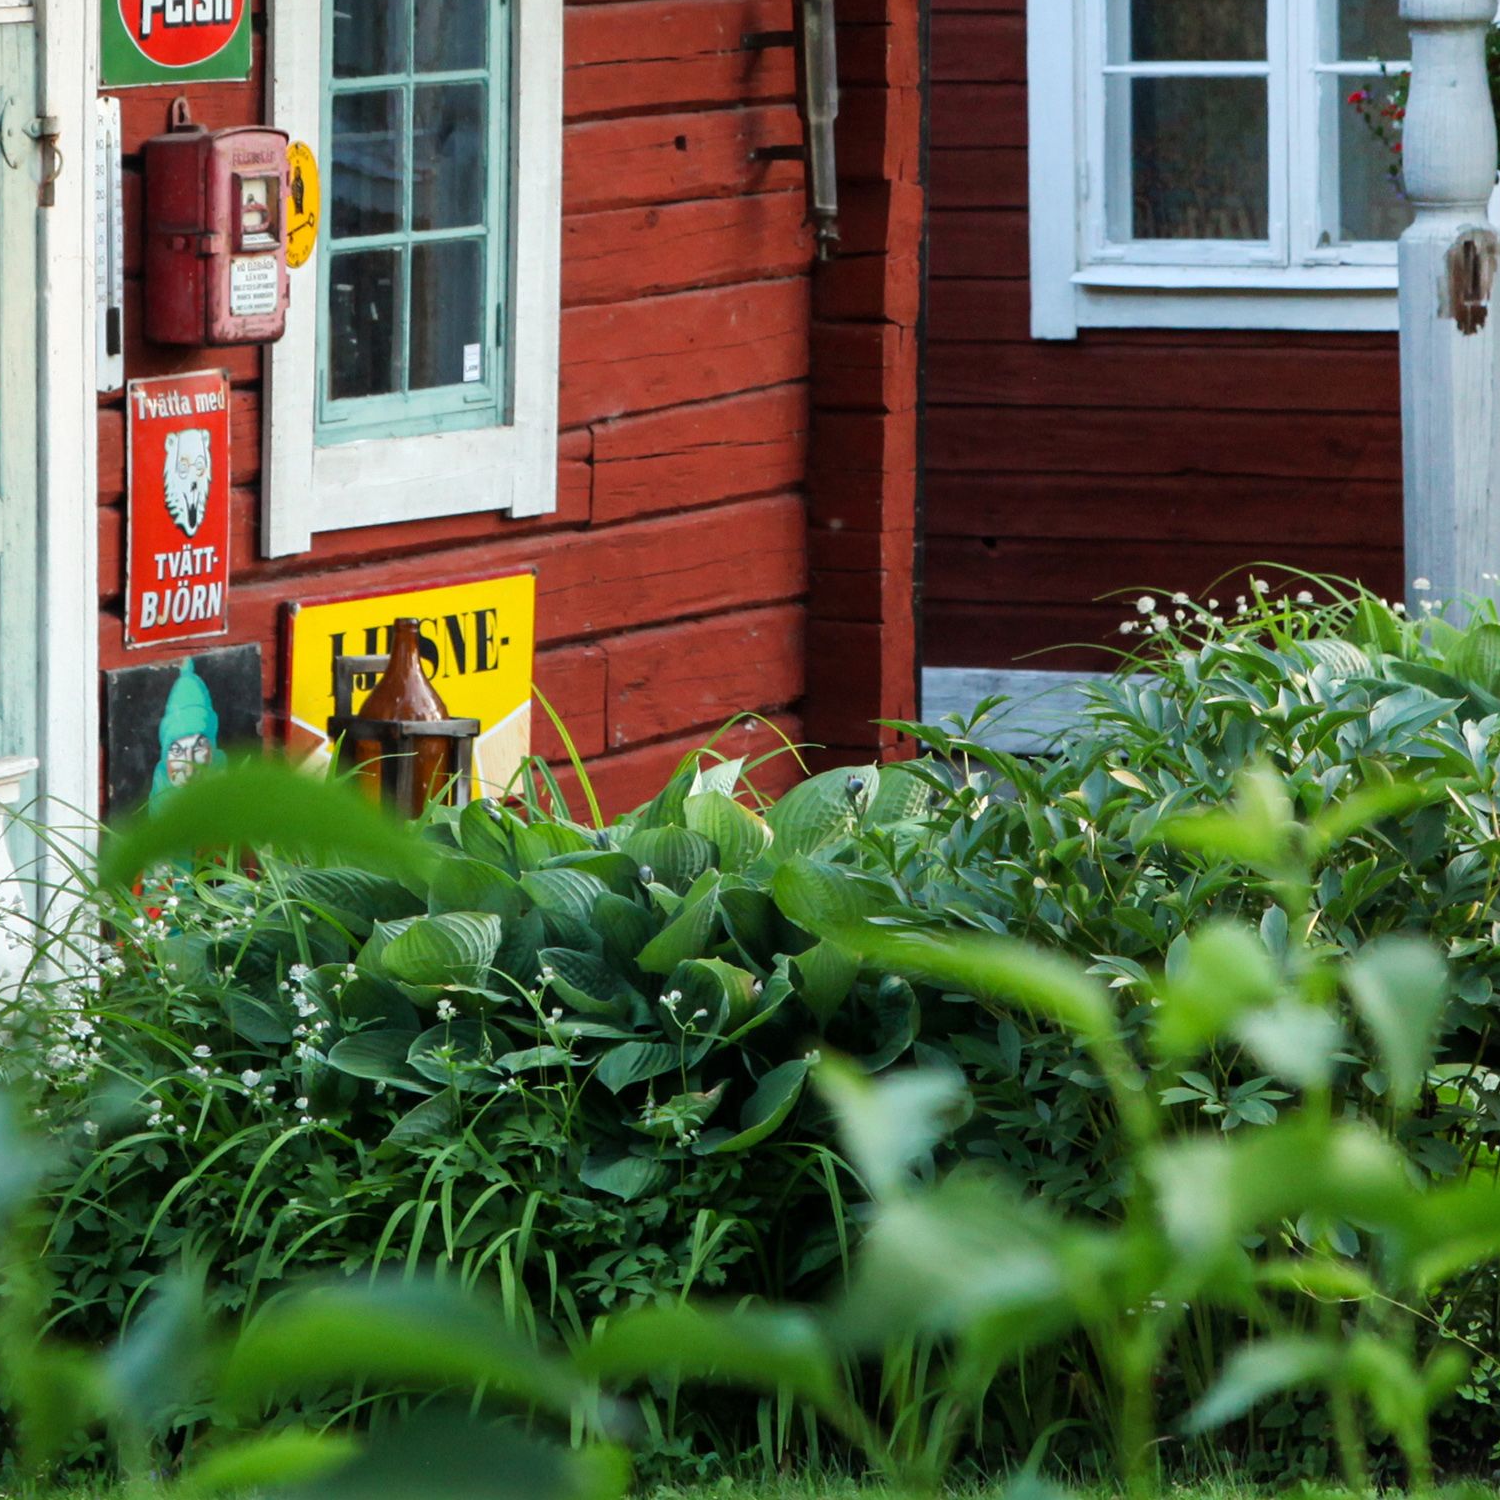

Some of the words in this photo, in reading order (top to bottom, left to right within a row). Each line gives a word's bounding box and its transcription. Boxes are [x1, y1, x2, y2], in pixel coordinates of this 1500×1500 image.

[134, 388, 192, 420] Tvätta
[194, 383, 226, 414] med
[154, 544, 219, 580] TVÄTT-
[140, 580, 222, 628] BJÖRN
